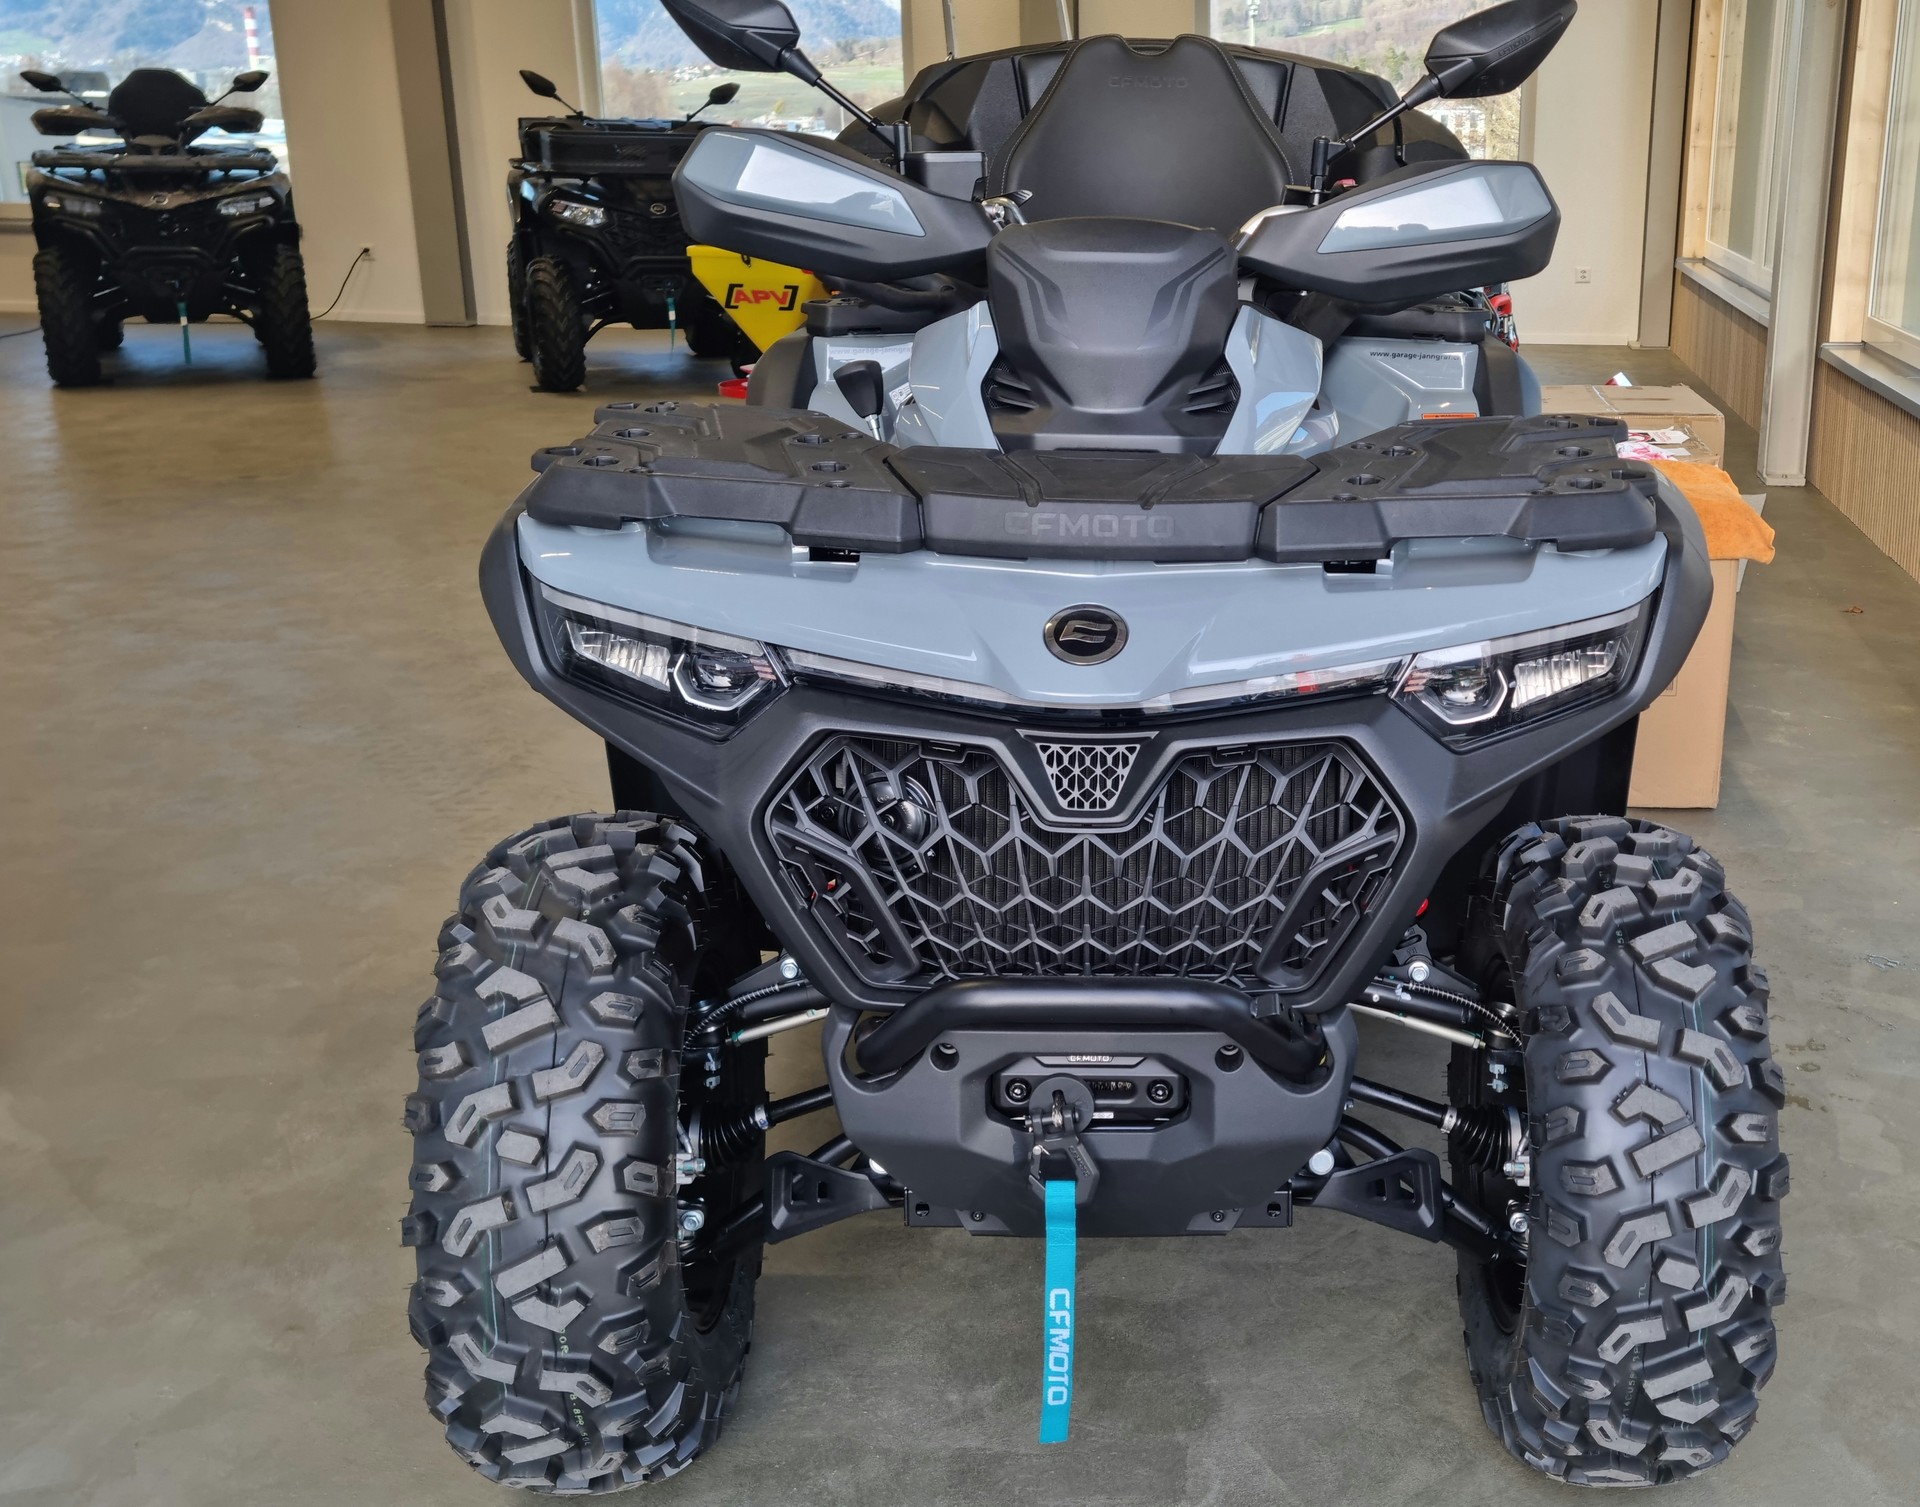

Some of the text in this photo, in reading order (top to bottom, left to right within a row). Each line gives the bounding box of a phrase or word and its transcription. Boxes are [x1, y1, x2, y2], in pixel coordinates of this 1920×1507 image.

[1108, 74, 1188, 88] CFMOTO
[1004, 511, 1175, 538] CFMOTO
[1047, 1288, 1071, 1406] CFMOTO
